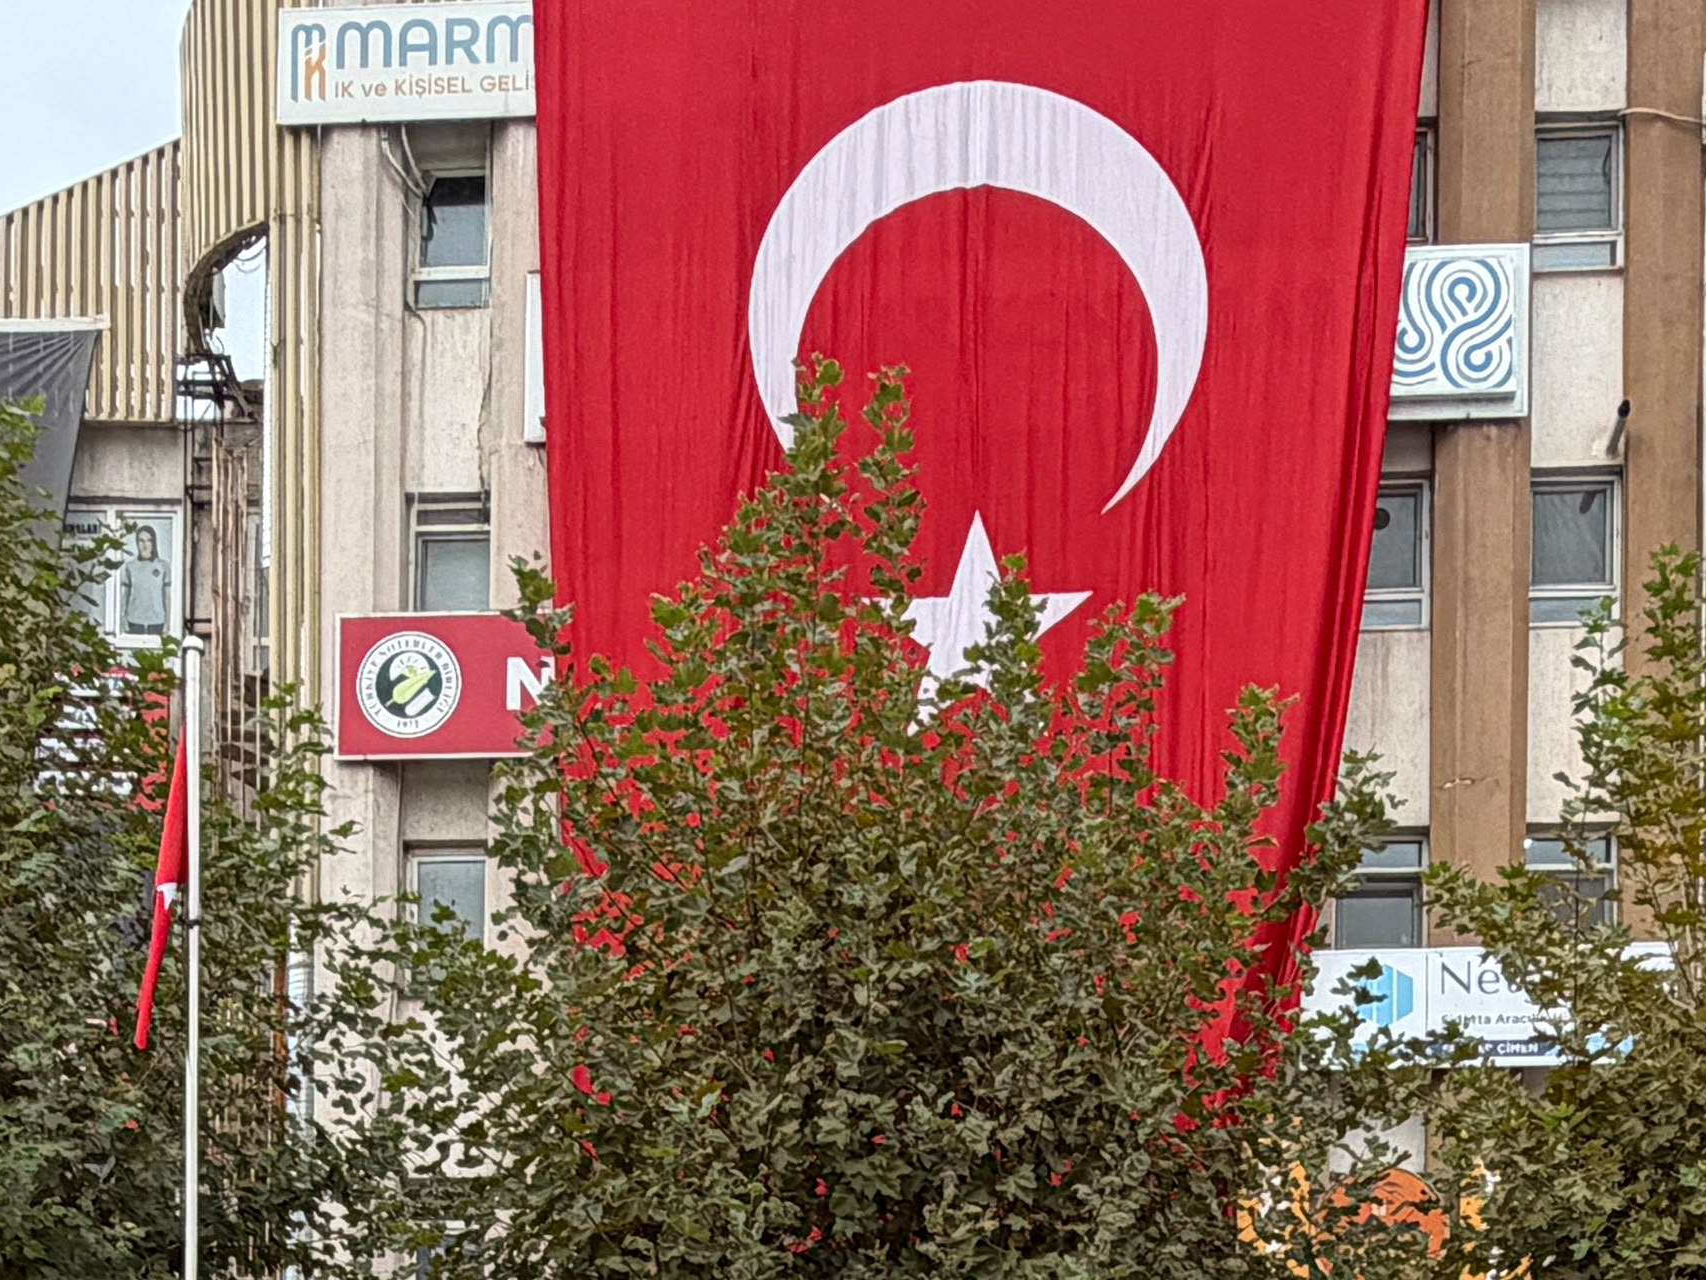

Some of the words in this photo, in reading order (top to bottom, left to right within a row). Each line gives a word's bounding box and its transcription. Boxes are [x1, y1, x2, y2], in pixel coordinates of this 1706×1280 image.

[361, 82, 388, 98] ve
[394, 74, 474, 99] KİŞİSEL
[479, 70, 534, 93] GELİ
